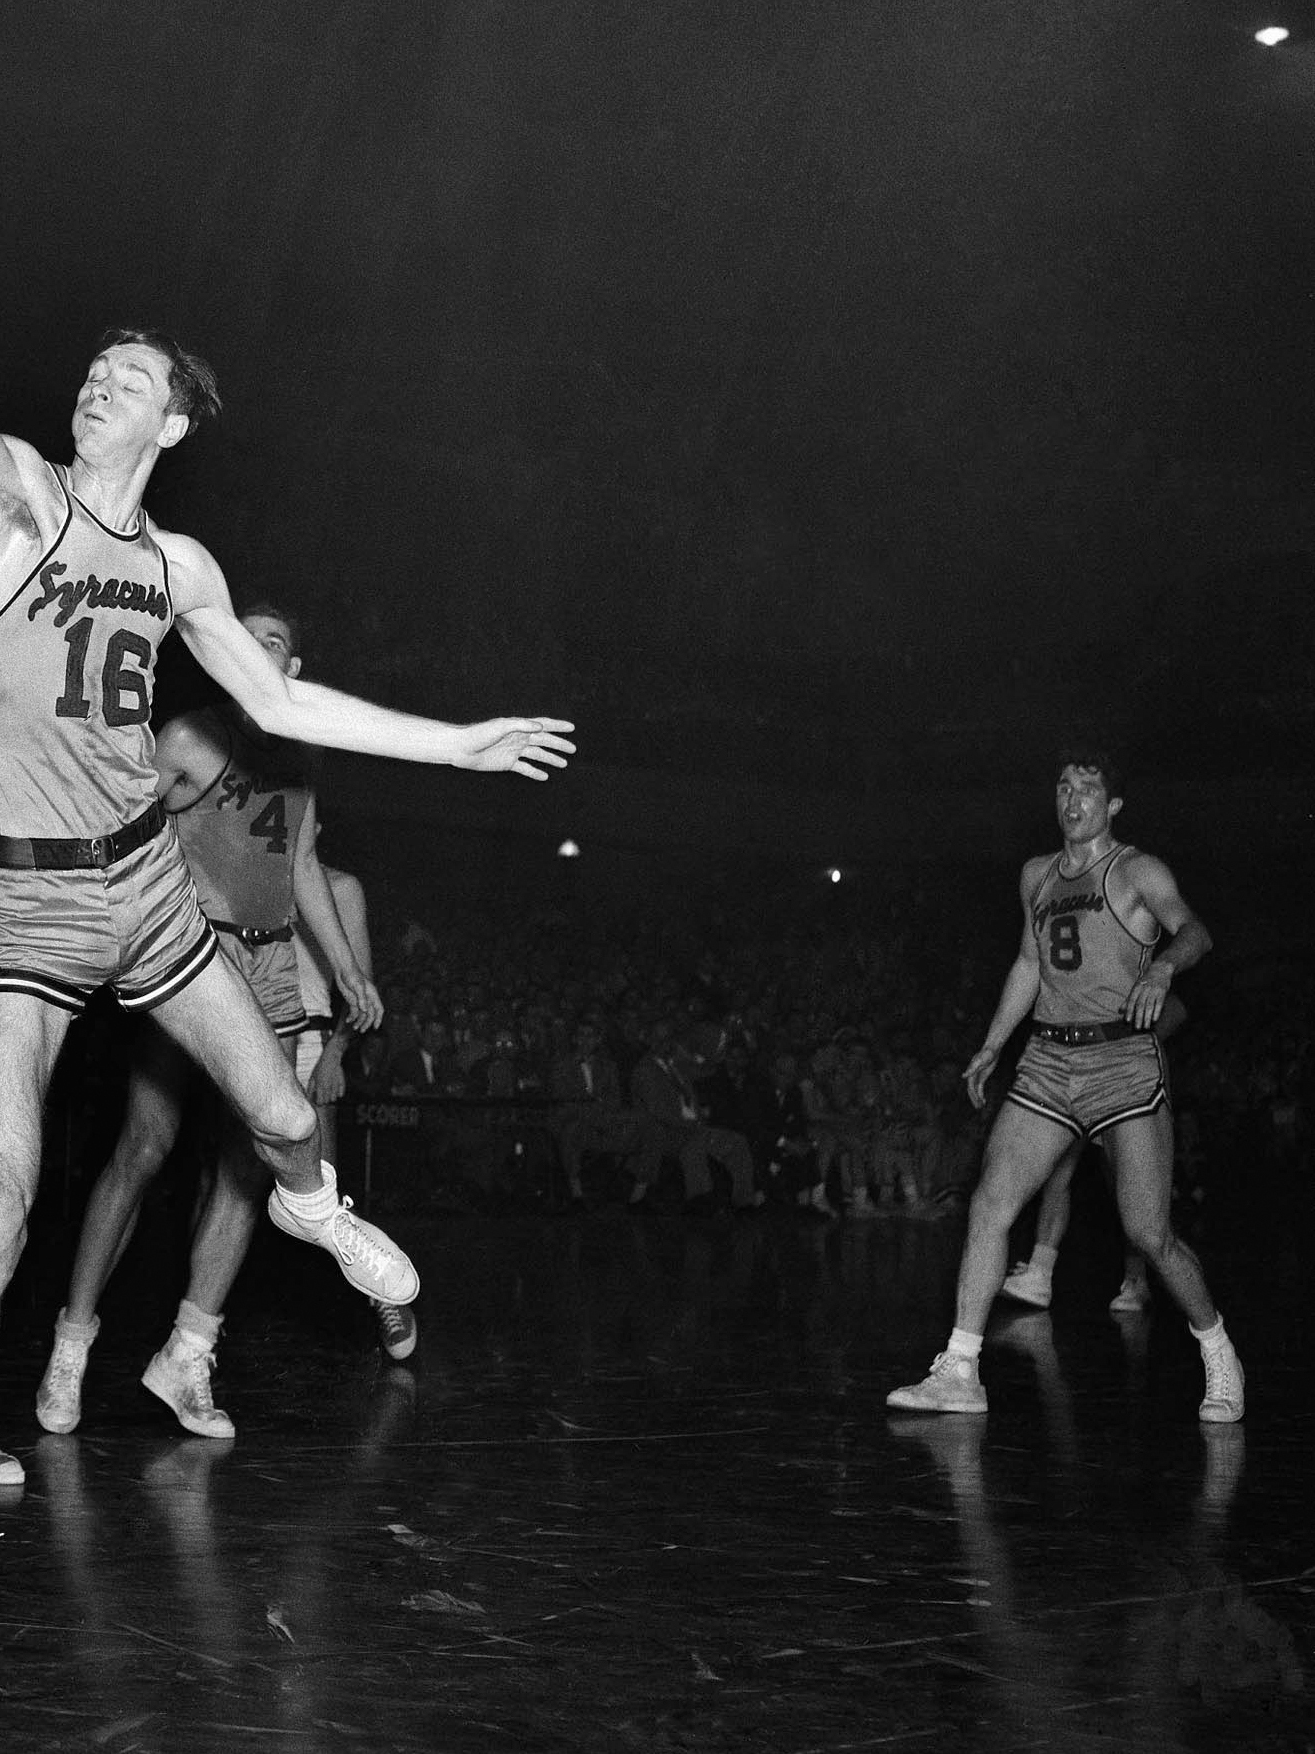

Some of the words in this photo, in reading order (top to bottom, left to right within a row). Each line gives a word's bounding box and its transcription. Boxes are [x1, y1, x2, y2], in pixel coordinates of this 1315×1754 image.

[27, 561, 168, 627] Syracuse
[56, 617, 151, 727] 16
[250, 795, 288, 855] 4
[1050, 915, 1082, 972] 8
[356, 1103, 420, 1126] SCORER
